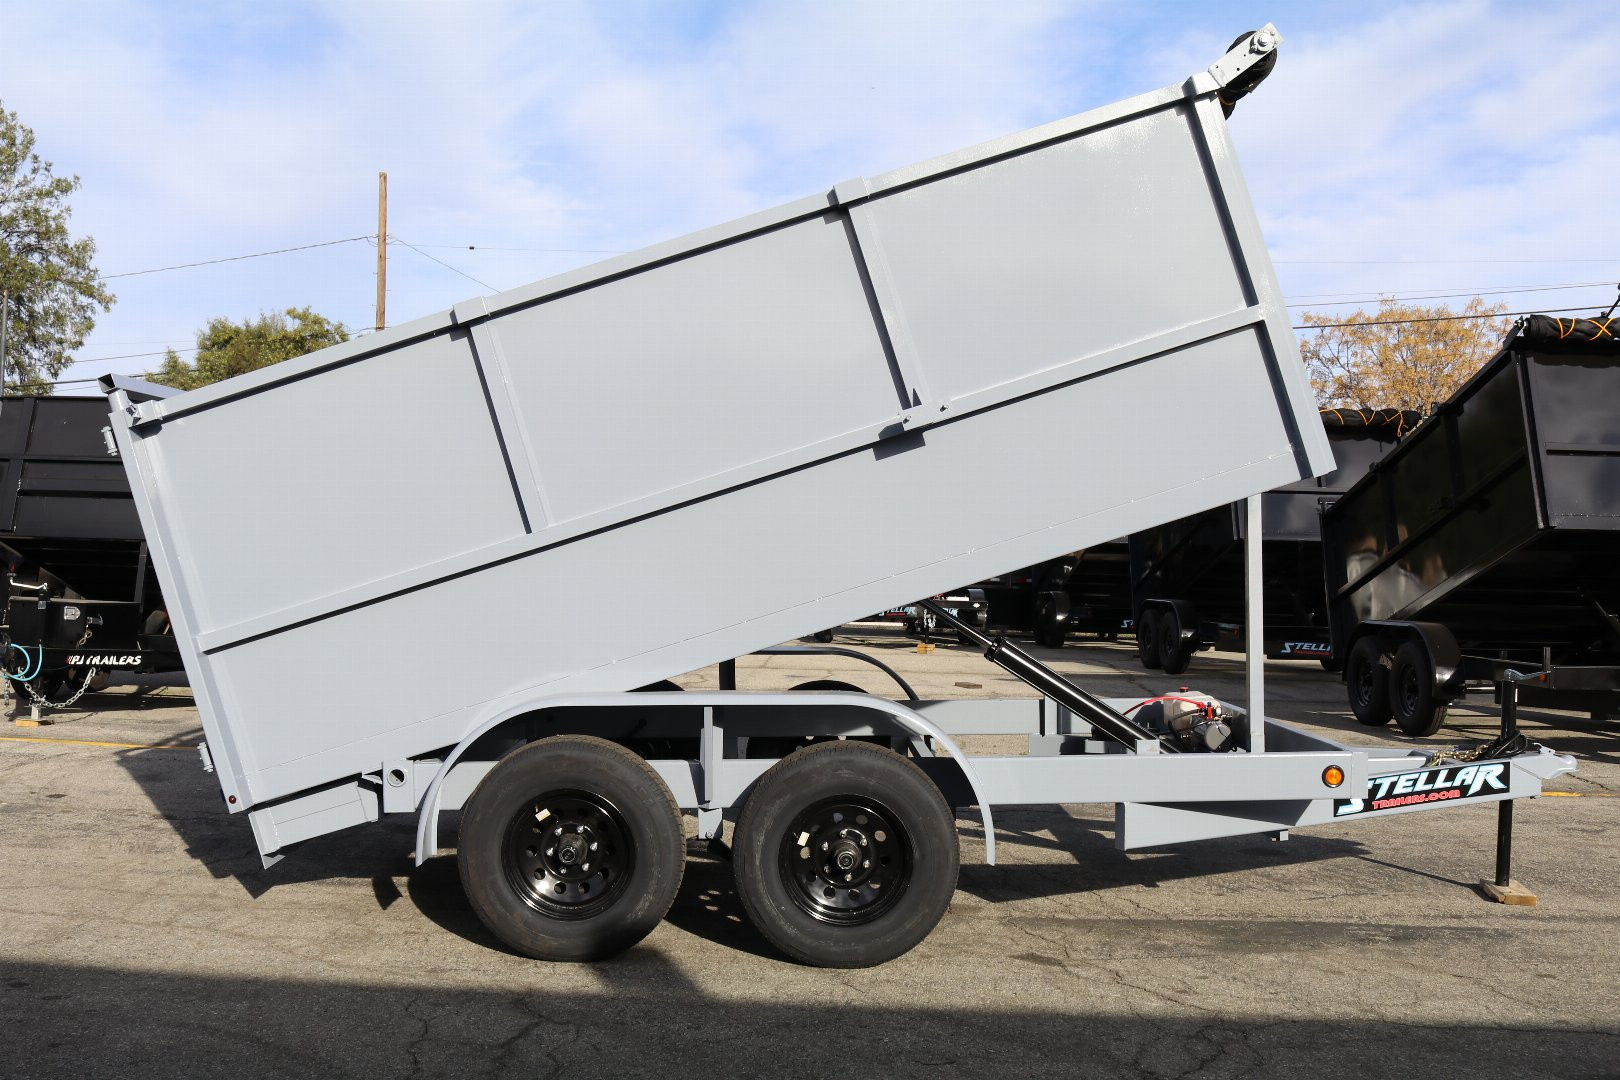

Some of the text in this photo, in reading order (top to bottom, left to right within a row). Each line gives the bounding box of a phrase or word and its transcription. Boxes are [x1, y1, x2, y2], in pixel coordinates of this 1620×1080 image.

[70, 656, 142, 665] PJ TRAILERS
[1372, 789, 1461, 810] TRAILERS.COM
